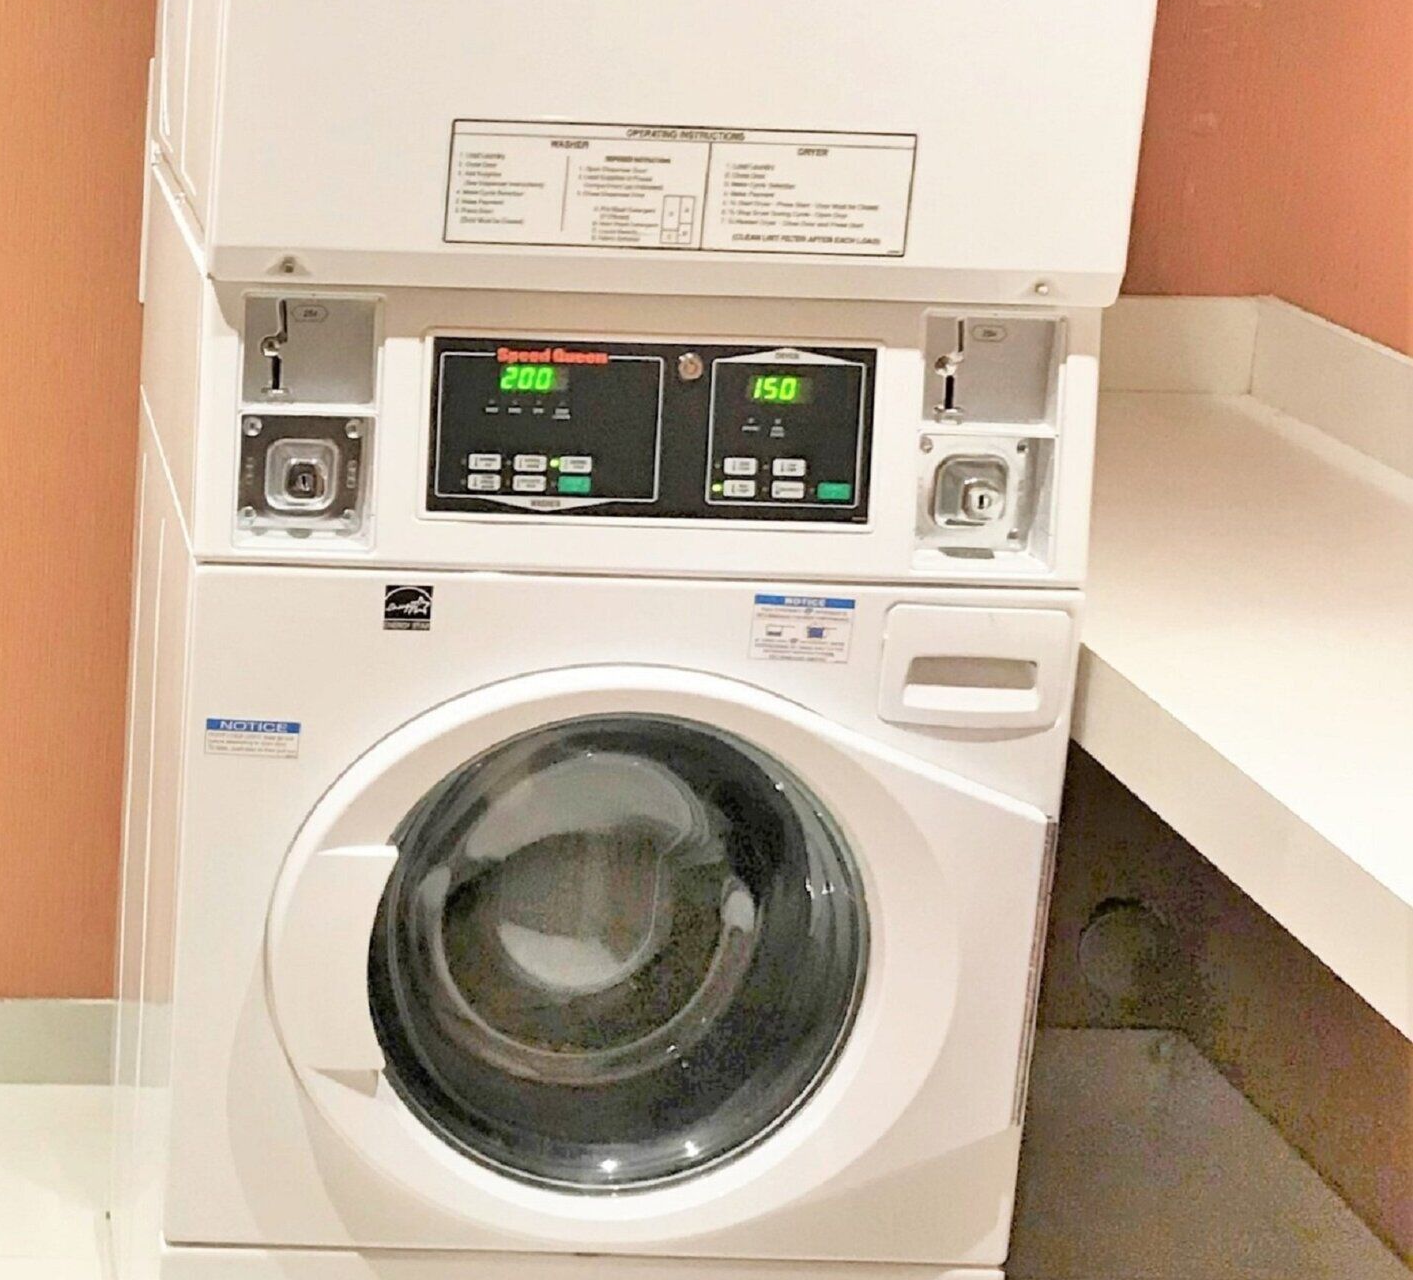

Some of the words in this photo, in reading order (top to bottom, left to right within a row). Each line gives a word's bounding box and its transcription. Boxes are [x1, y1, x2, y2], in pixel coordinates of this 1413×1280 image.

[497, 347, 552, 364] Speed
[552, 348, 608, 364] Queen
[500, 366, 553, 390] 200
[753, 377, 797, 400] 150
[784, 598, 826, 608] NOTICE
[219, 720, 288, 733] NOTICE
